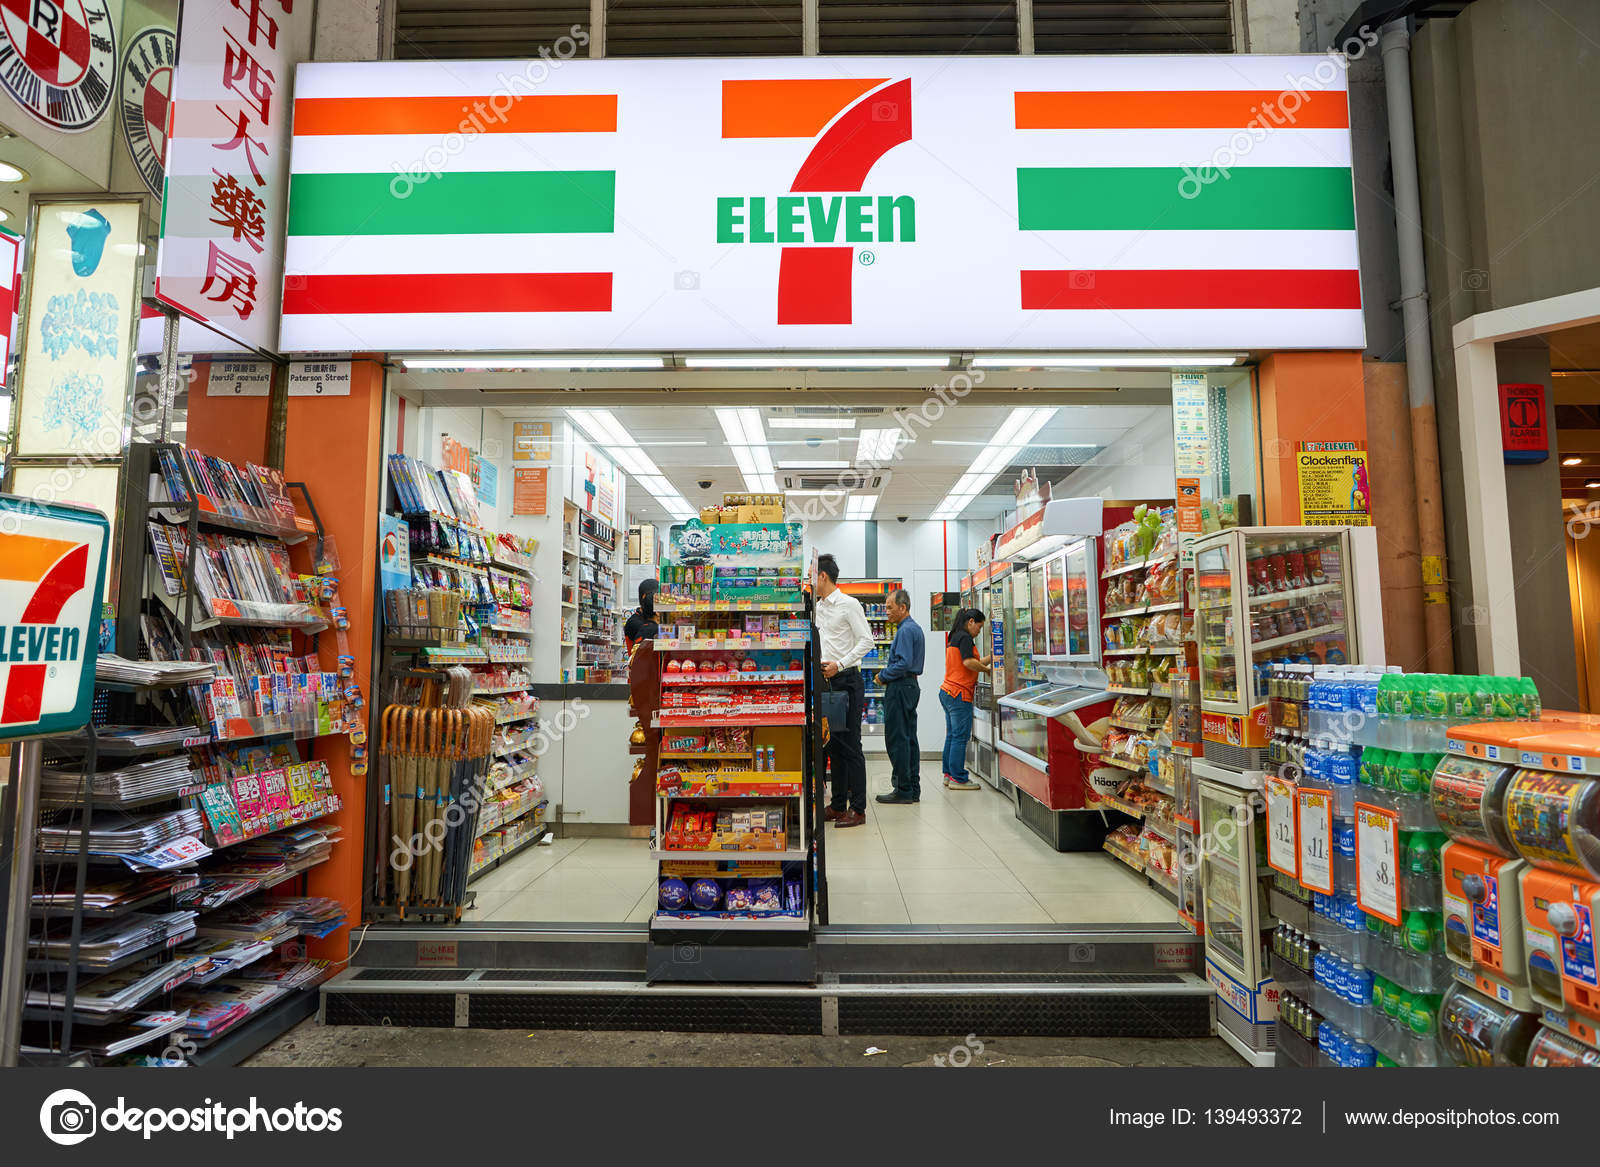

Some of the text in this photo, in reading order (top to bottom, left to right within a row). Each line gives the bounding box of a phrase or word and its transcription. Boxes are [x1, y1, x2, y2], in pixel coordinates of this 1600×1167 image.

[325, 373, 349, 381] Street
[315, 382, 323, 394] 5
[1301, 456, 1364, 466] Clockenflap
